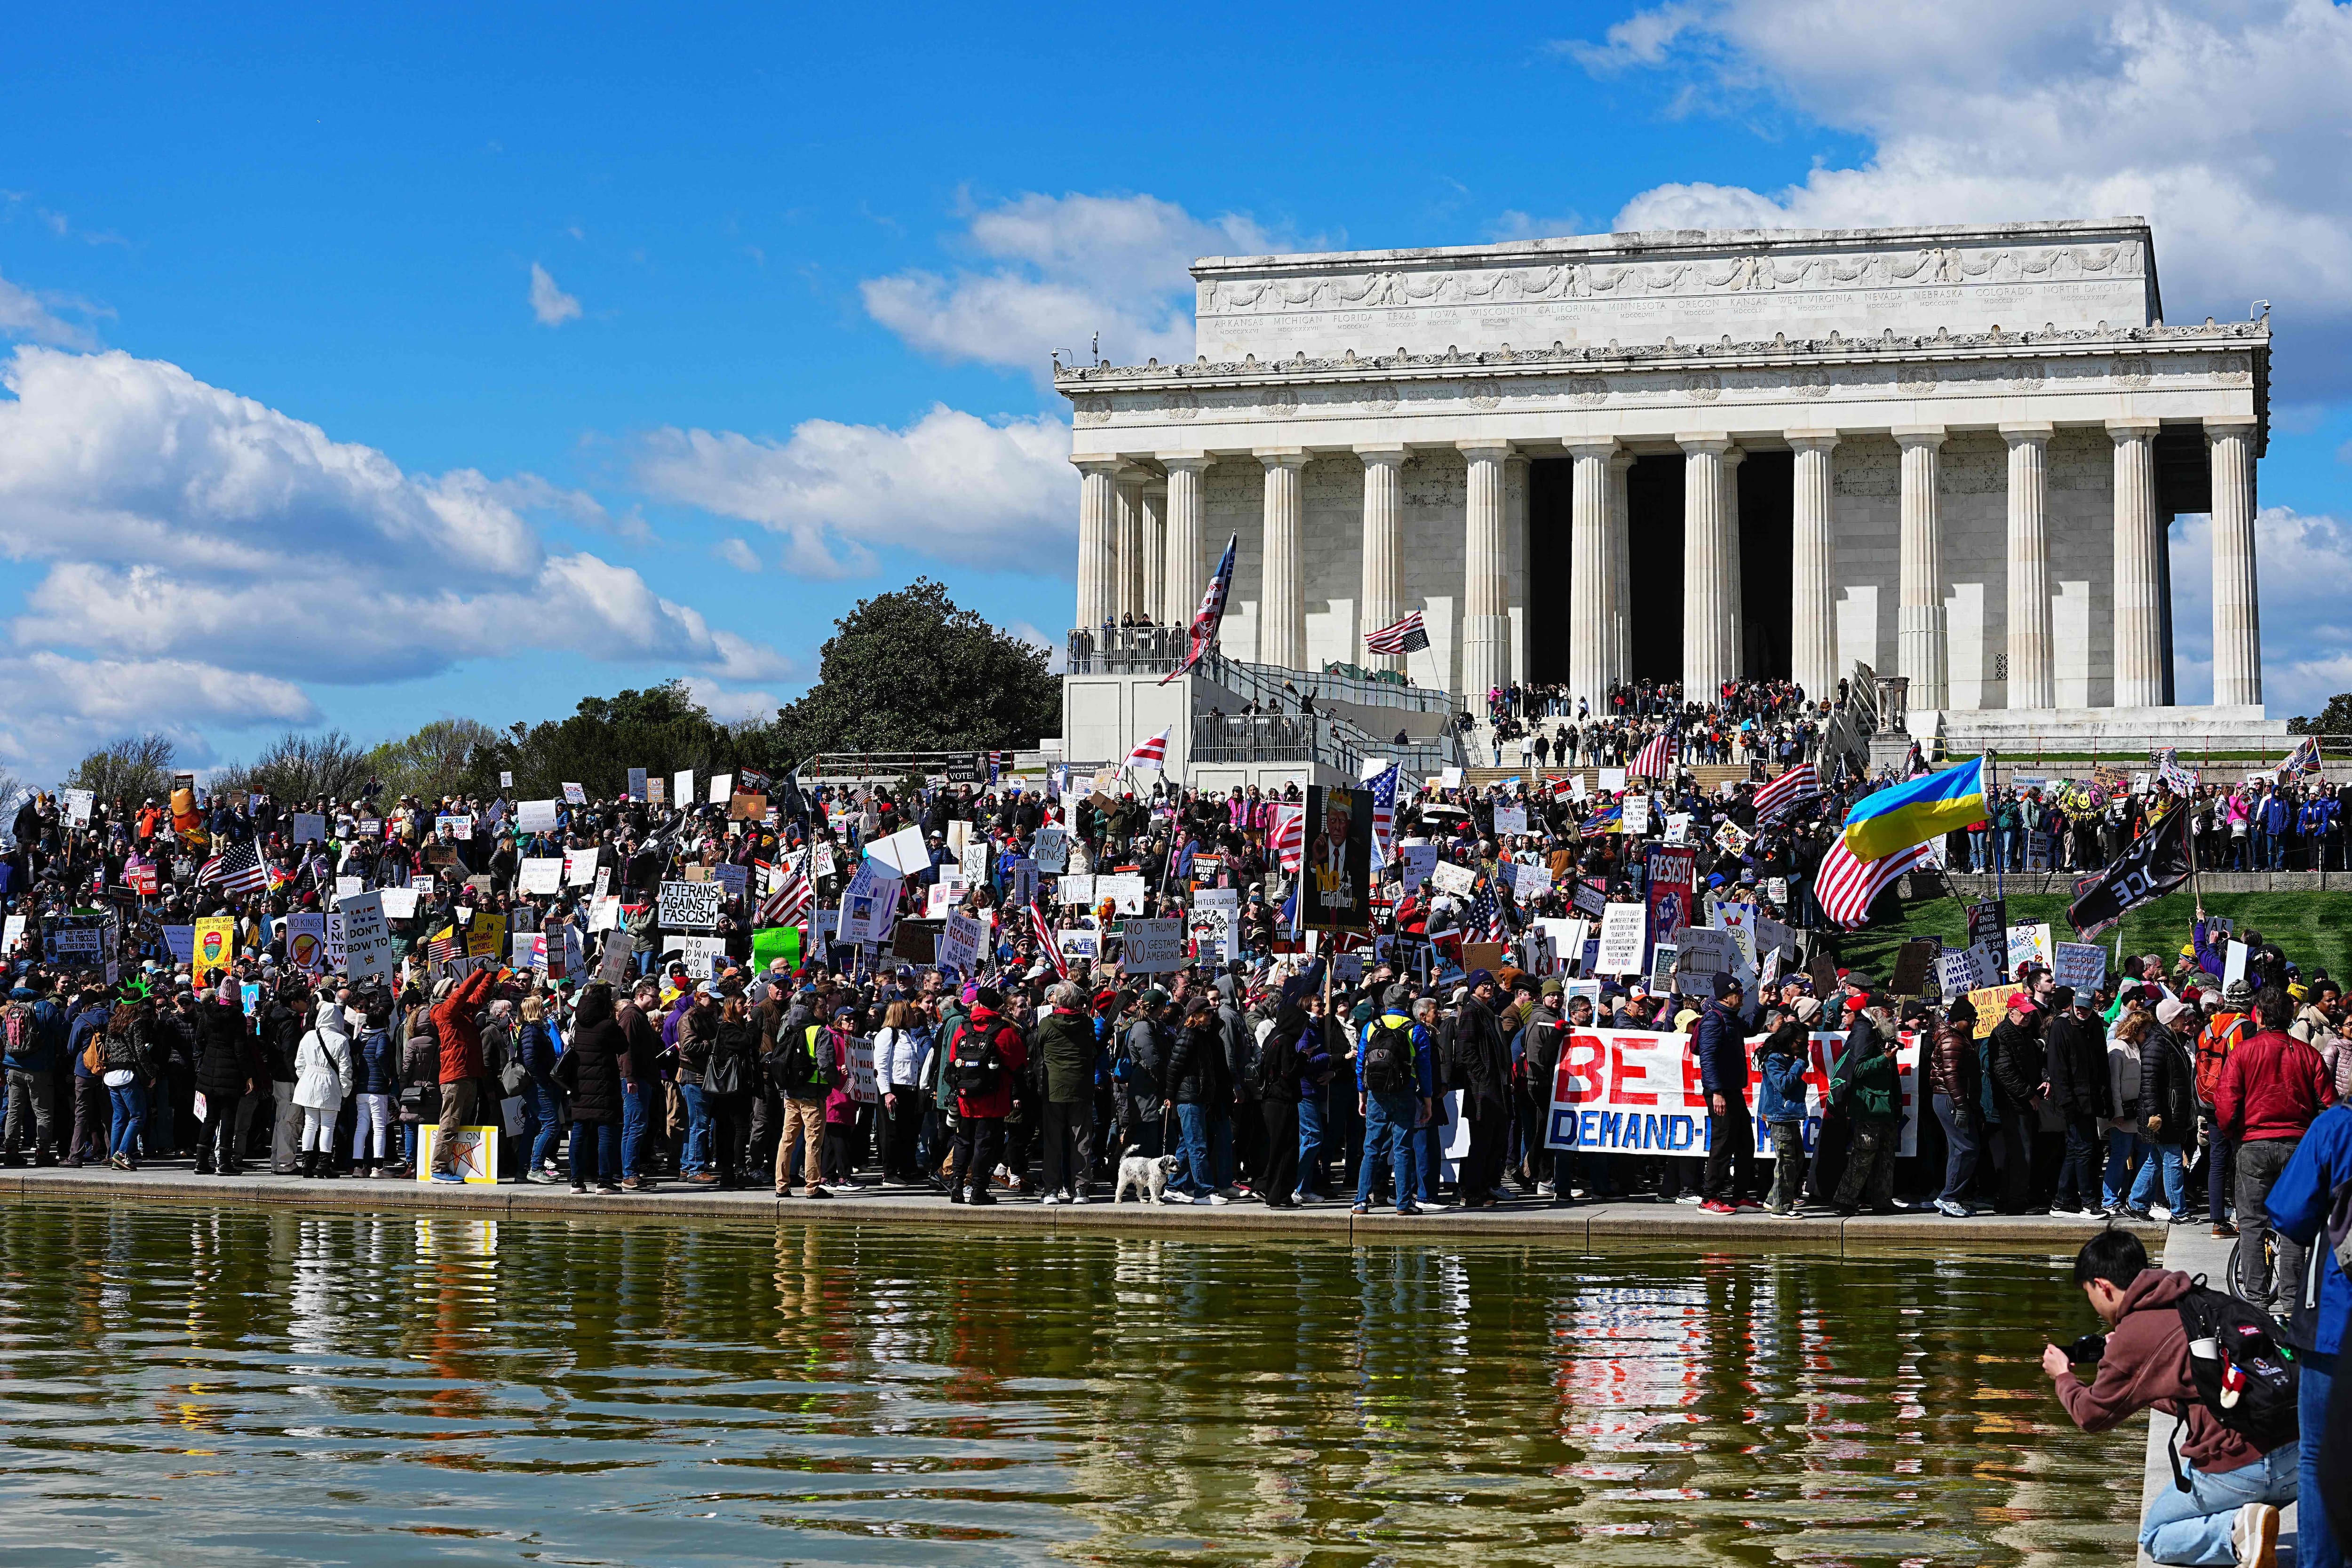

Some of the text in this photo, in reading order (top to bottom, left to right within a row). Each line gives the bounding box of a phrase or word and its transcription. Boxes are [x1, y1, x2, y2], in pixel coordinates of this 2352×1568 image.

[1976, 287, 2033, 297] COLORADO
[2043, 283, 2123, 294] NORTH DAKOTA
[1779, 294, 1854, 305] WEST VIRGINIA
[1865, 291, 1904, 301] NEVADA
[1914, 289, 1964, 300] NEBRASKA
[1608, 301, 1666, 311] MINNESOTA
[1678, 299, 1720, 309] OREGON
[1730, 297, 1768, 307] KANSAS
[1430, 310, 1457, 318] IOWA
[1470, 306, 1527, 316] WISCONSIN
[1538, 305, 1597, 314] CALIFORNIA
[1274, 316, 1322, 325] MICHIGAN
[1333, 313, 1373, 322] FLORIDA
[1387, 311, 1416, 320] TEXAS
[1215, 318, 1264, 327] ARKANSAS
[2051, 367, 2104, 376] VIRGINIA
[2180, 364, 2208, 373] YORK
[1837, 375, 1890, 384] CAROLINA
[1939, 371, 2003, 380] HAMPSHIRE
[1725, 378, 1786, 388] MARYLAND
[1407, 390, 1456, 399] GEORGIA
[1503, 384, 1567, 396] CONNECTICUT
[1200, 396, 1261, 406] PENNSYLVANIA
[1300, 393, 1358, 403] NEW JERSEY
[1112, 401, 1164, 411] DELAWARE
[742, 771, 759, 779] TRUMP
[742, 775, 756, 784] MUST
[1555, 785, 1571, 794] SALE
[1042, 835, 1057, 846] NO
[969, 848, 981, 859] NO
[1036, 849, 1065, 862] KINGS
[964, 858, 984, 870] KINGS
[1649, 854, 1692, 884] RESIST!
[660, 883, 718, 898] VETERANS
[1059, 881, 1072, 902] NO
[661, 898, 715, 910] AGAINST
[1576, 889, 1604, 912] EPSTEIN?
[350, 906, 376, 923] WE
[663, 909, 715, 923] FASCISM
[1979, 914, 1995, 923] ENDS
[289, 918, 321, 927] NO KINGS
[953, 915, 977, 936] WE'RE HERE
[1210, 910, 1227, 934] PIRATE
[350, 924, 380, 938] DON'T
[1125, 923, 1178, 934] NO TRUMP
[1978, 923, 1997, 932] WHEN
[763, 931, 787, 940] STOP
[949, 927, 974, 947] BECAUSE
[1975, 931, 2001, 943] ENOUGH
[347, 938, 387, 953] BOW TO
[548, 939, 564, 949] LARGUE
[763, 943, 786, 952] GOP
[549, 952, 564, 962] TRUMP
[952, 943, 972, 961] WE LOVE
[1125, 940, 1178, 964] NO GESTAPO
[1146, 951, 1178, 961] AMERICA!!
[2009, 945, 2039, 966] REALIZE
[1947, 951, 1972, 966] MAKE
[1946, 959, 1980, 976] AMERICA
[1948, 968, 1983, 985] AMERICA
[1973, 992, 1991, 1006] DUMP
[858, 1042, 872, 1051] KINGS
[1555, 1036, 1658, 1105] BE
[854, 1089, 875, 1101] NO HATE
